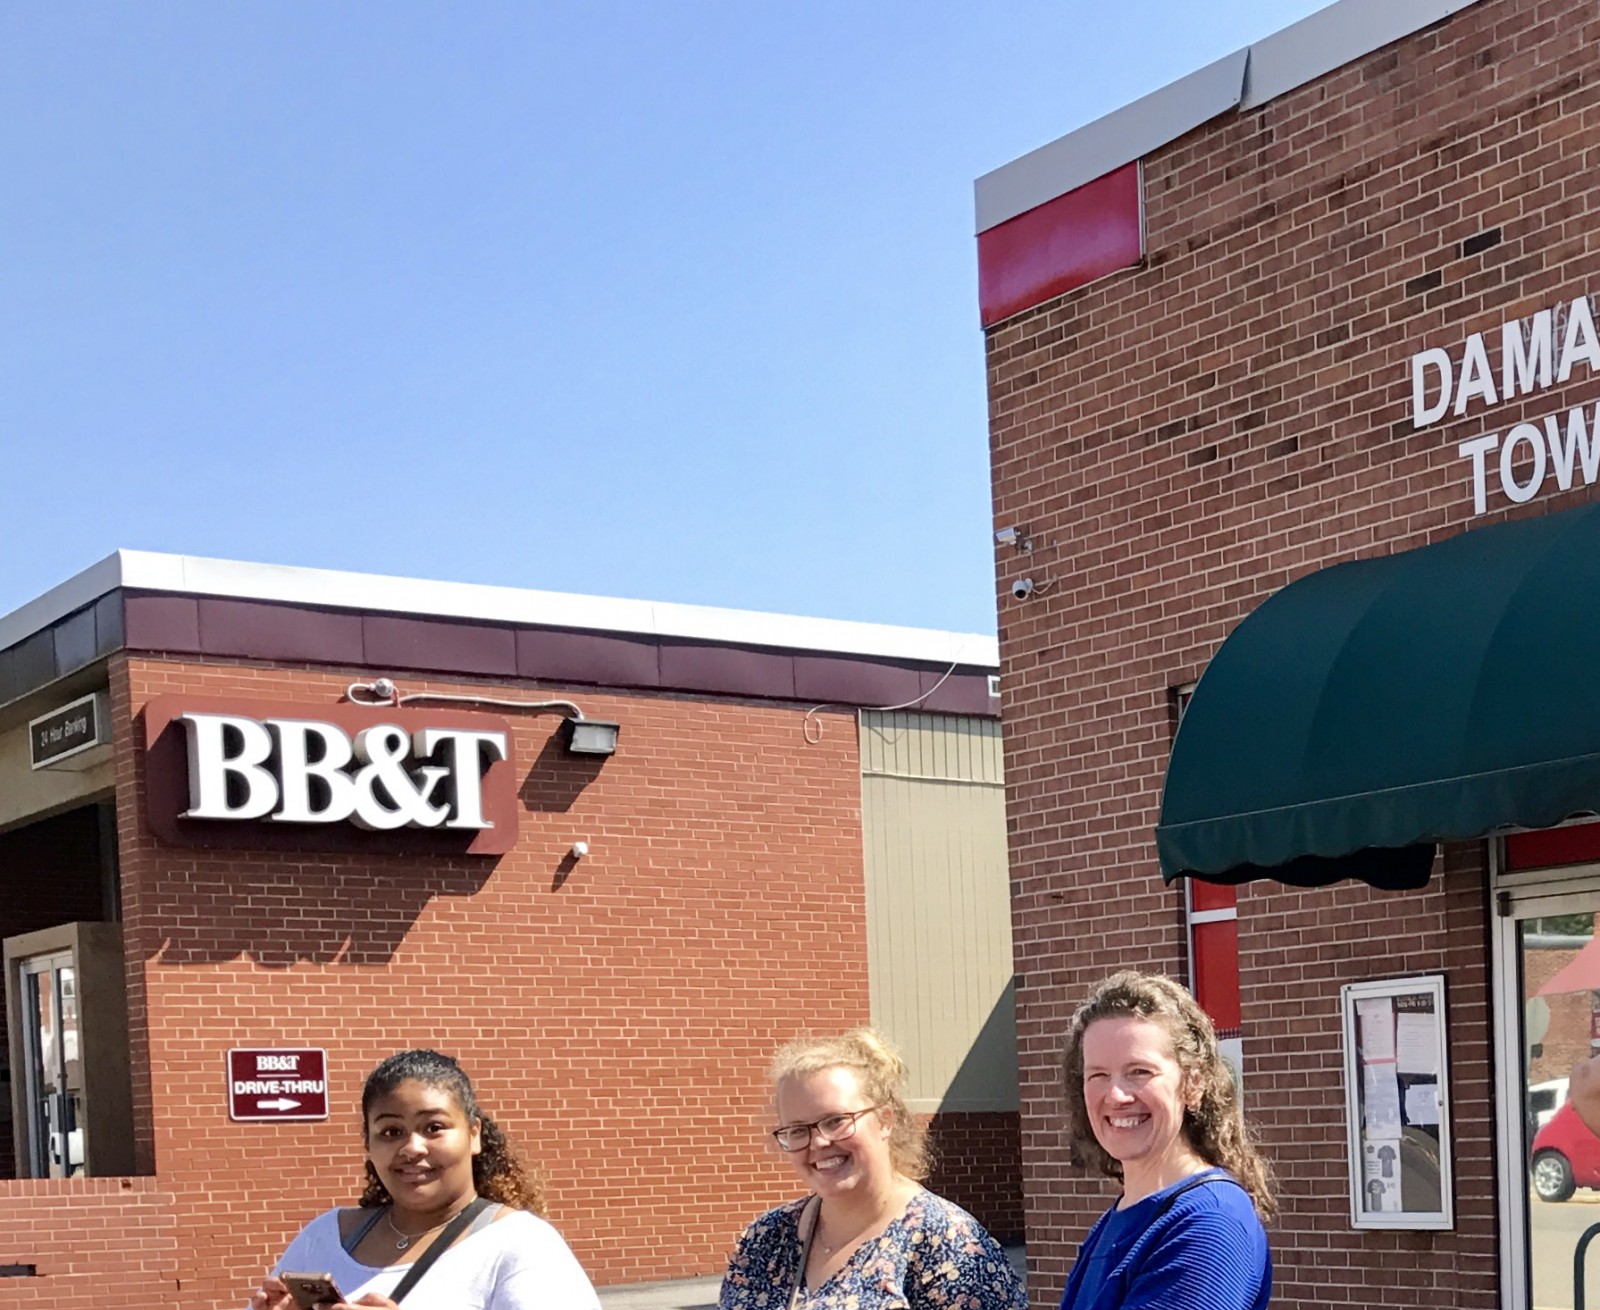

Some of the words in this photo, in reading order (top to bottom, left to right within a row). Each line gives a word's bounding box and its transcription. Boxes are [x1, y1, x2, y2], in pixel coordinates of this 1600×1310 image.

[175, 711, 508, 831] BB&T
[256, 1055, 300, 1071] BB&T
[234, 1080, 324, 1095] DRIVE-THRU
